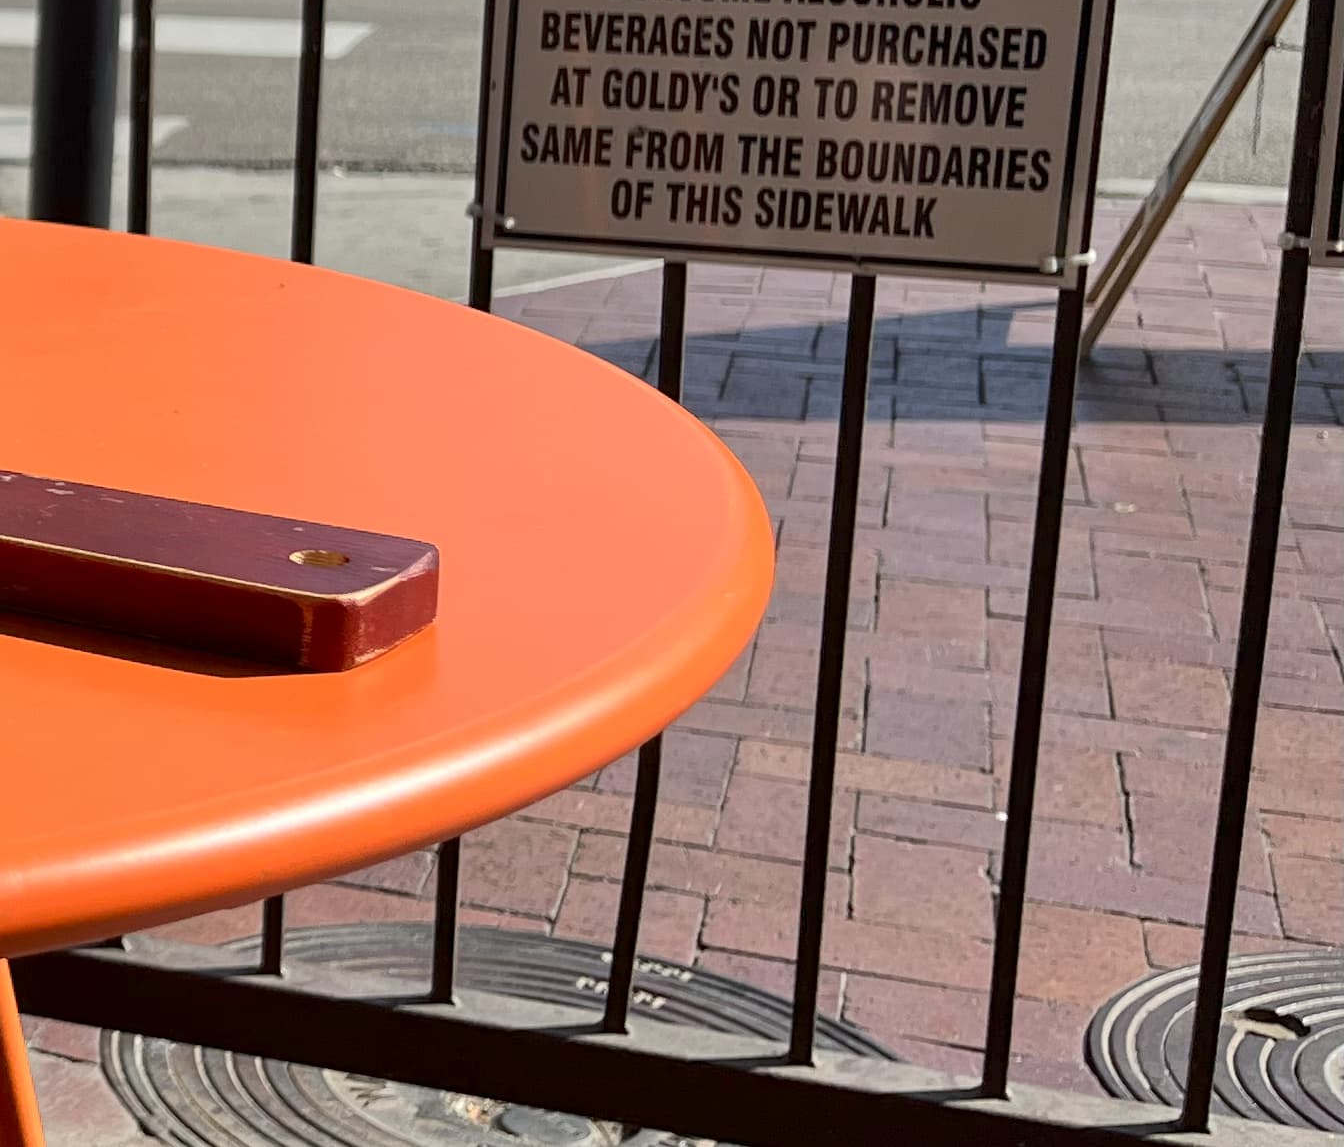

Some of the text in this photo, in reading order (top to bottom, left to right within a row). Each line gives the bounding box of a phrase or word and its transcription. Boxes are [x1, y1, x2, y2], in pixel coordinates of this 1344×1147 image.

[540, 11, 1048, 71] BEVERAGES NOT PURCHASED
[550, 66, 1028, 129] AT GOLDY'S OR TO REMOVE
[520, 123, 1052, 192] SAME FROM THE BOUNDARIES
[611, 178, 938, 239] OF THIS SIDEWALK
